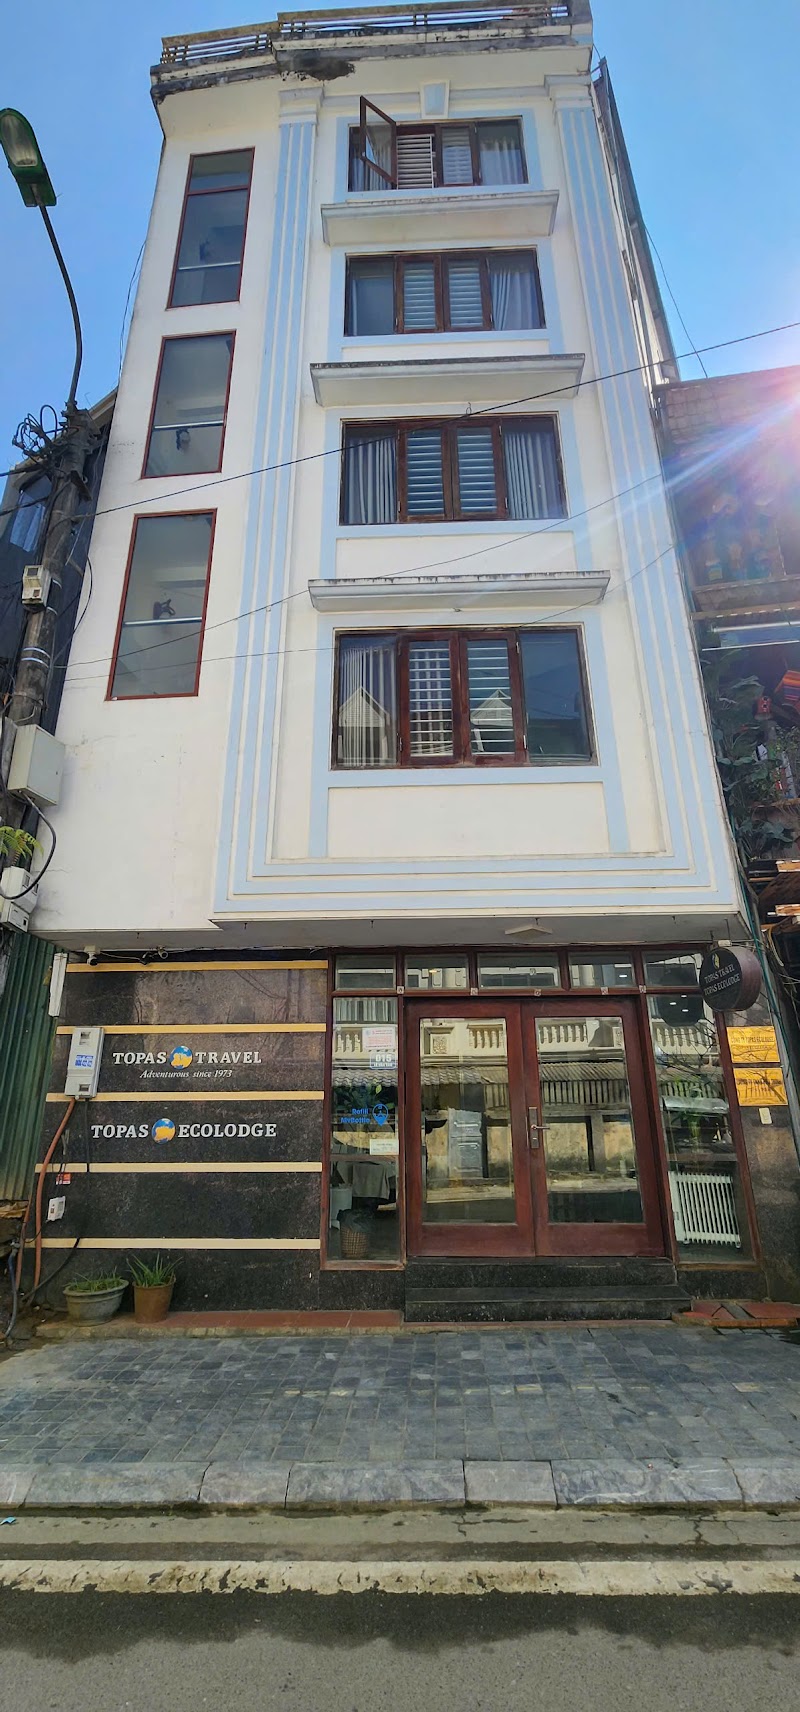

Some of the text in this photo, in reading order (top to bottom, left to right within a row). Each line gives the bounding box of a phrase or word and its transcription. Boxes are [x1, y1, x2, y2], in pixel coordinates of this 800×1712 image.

[112, 1051, 262, 1065] TOPAS TRAVEL
[139, 1069, 233, 1079] Adventurous since 1973
[91, 1123, 277, 1138] TOPAS ECOLODGE
